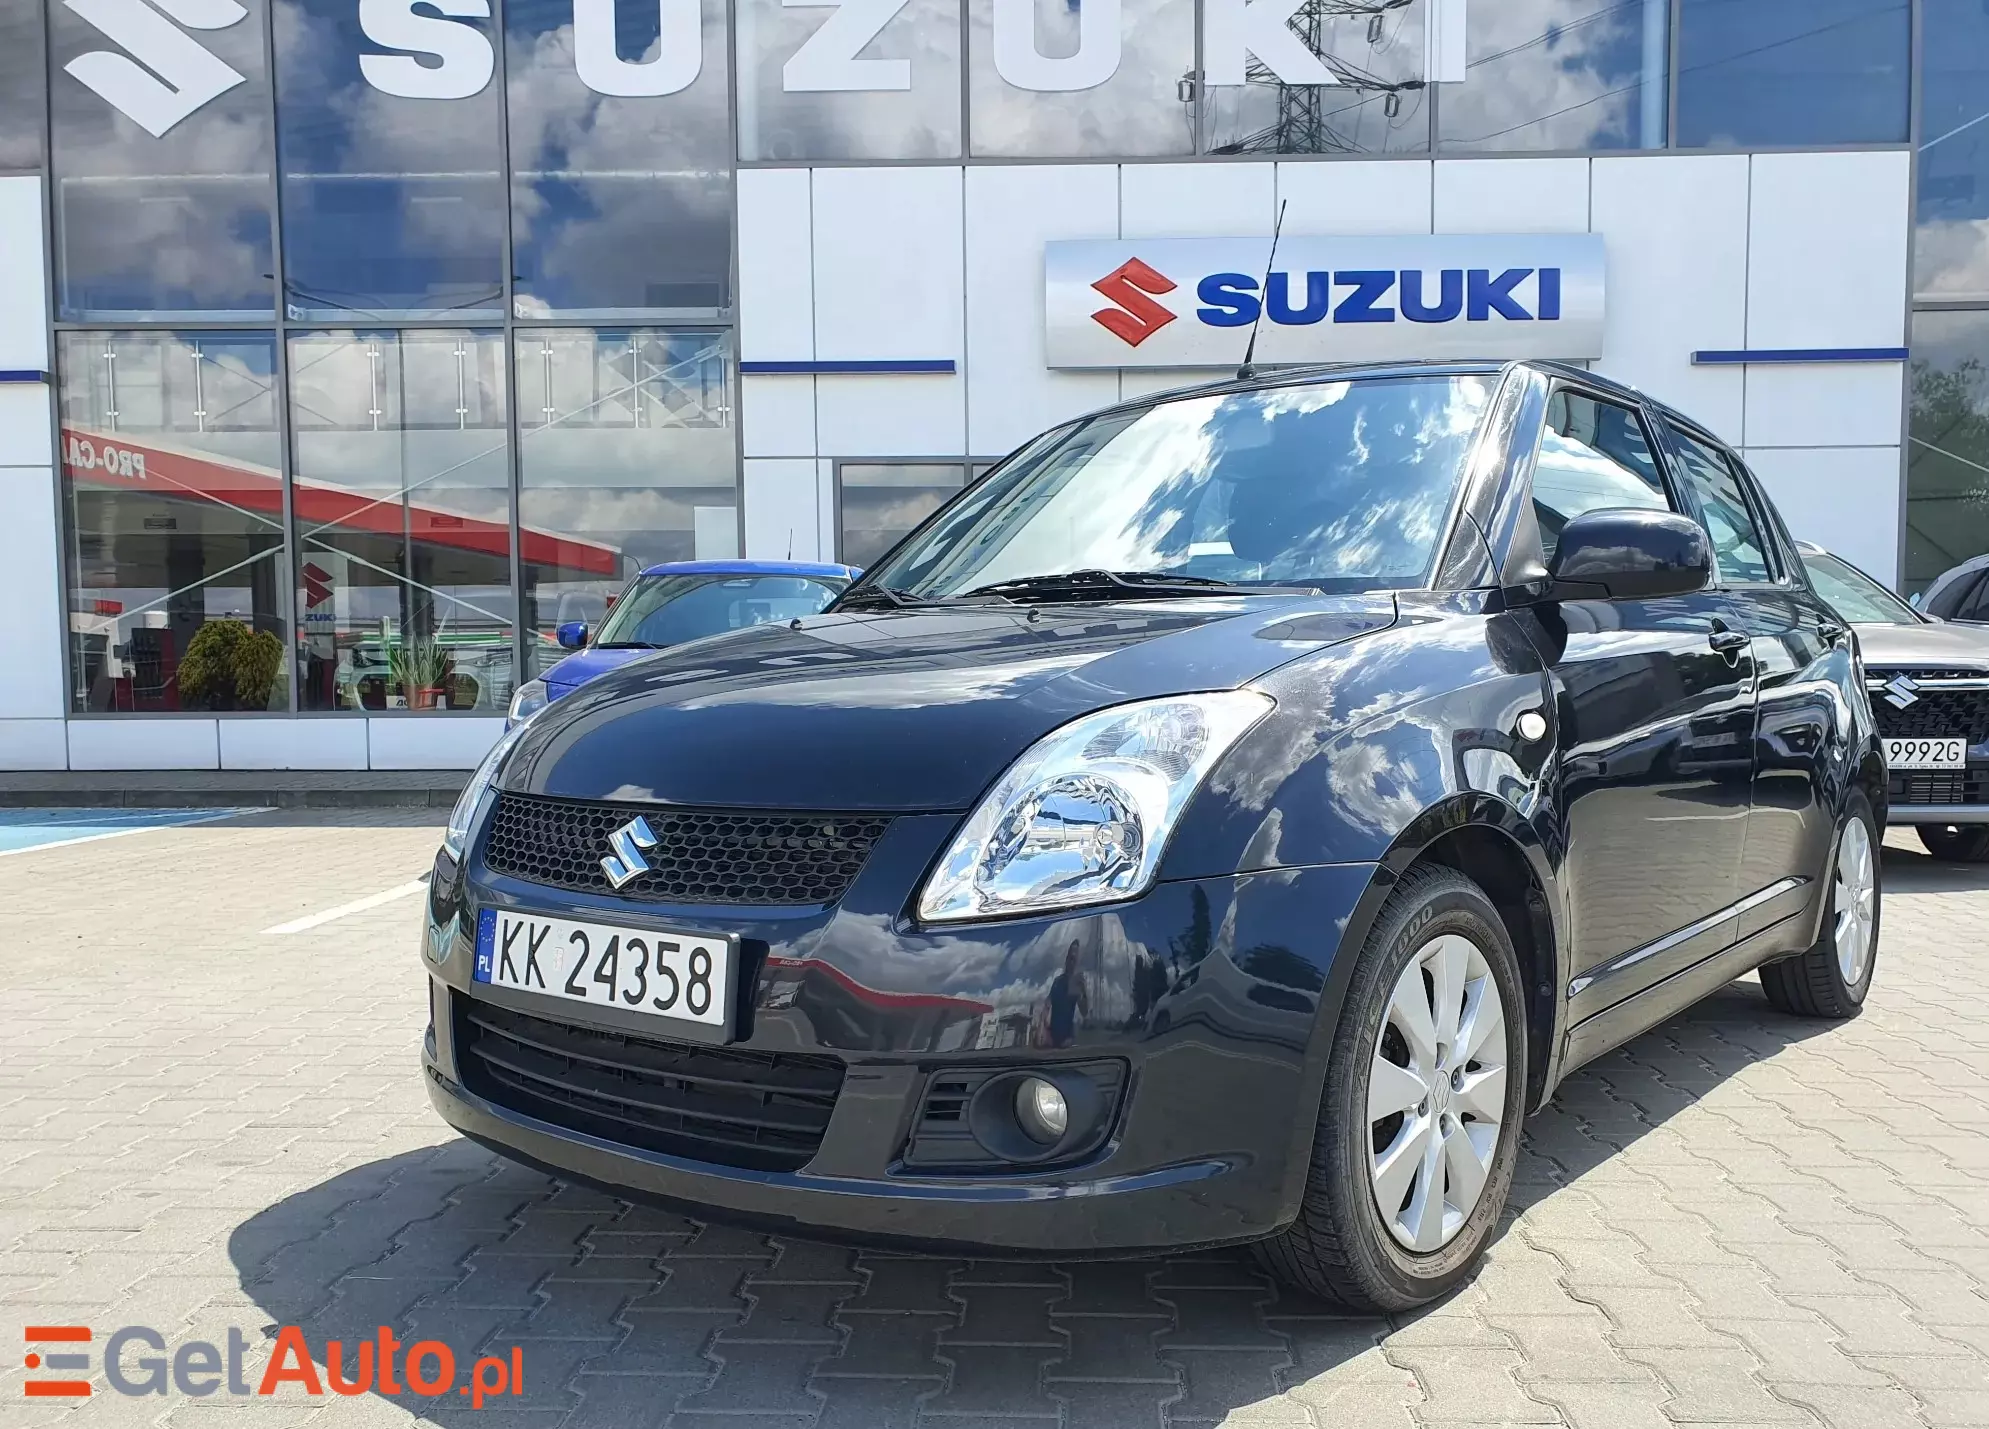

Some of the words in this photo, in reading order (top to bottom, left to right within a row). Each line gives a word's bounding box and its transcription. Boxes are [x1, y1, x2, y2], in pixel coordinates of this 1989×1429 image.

[359, 0, 1466, 99] SUZUKI
[1196, 267, 1561, 327] SUZUKI
[1889, 741, 1960, 762] 9992G
[478, 954, 491, 973] PL
[499, 918, 552, 989] KK
[564, 929, 713, 1016] 24358
